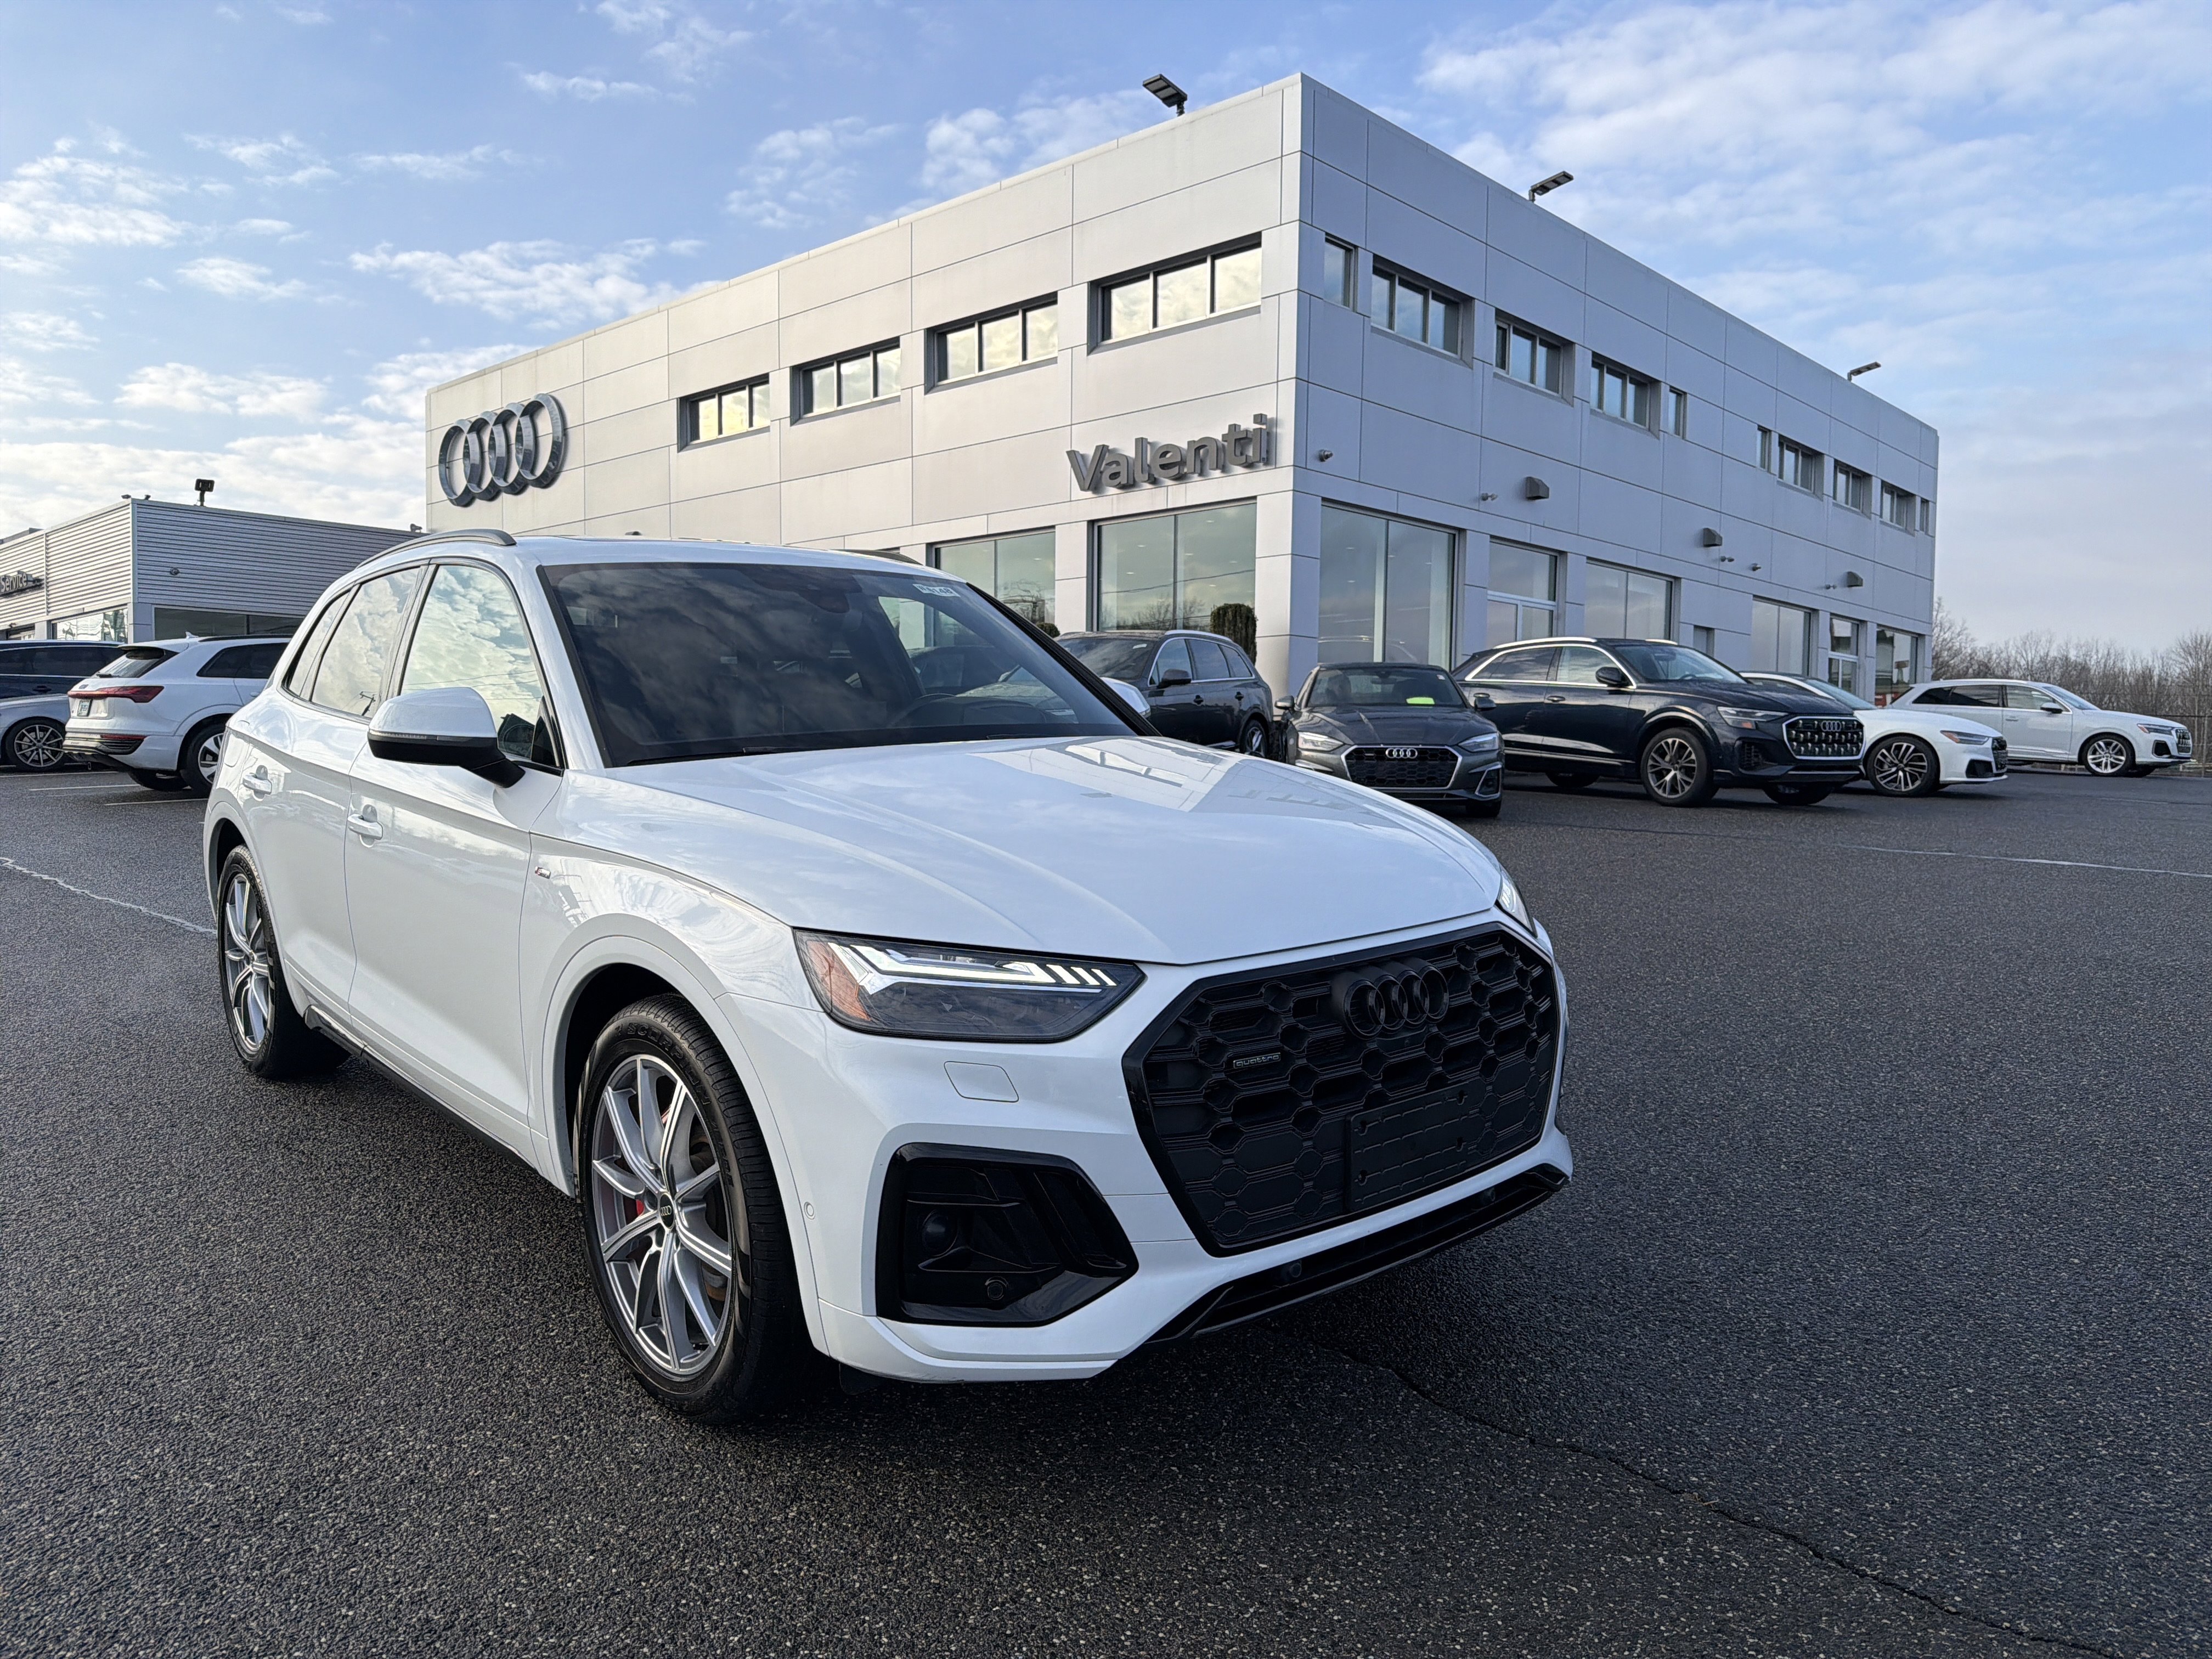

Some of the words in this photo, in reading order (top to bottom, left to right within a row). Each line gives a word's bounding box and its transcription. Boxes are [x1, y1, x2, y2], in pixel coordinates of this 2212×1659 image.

[1066, 413, 1268, 492] Valenti
[1, 571, 27, 592] Service
[1236, 1054, 1279, 1067] quattro
